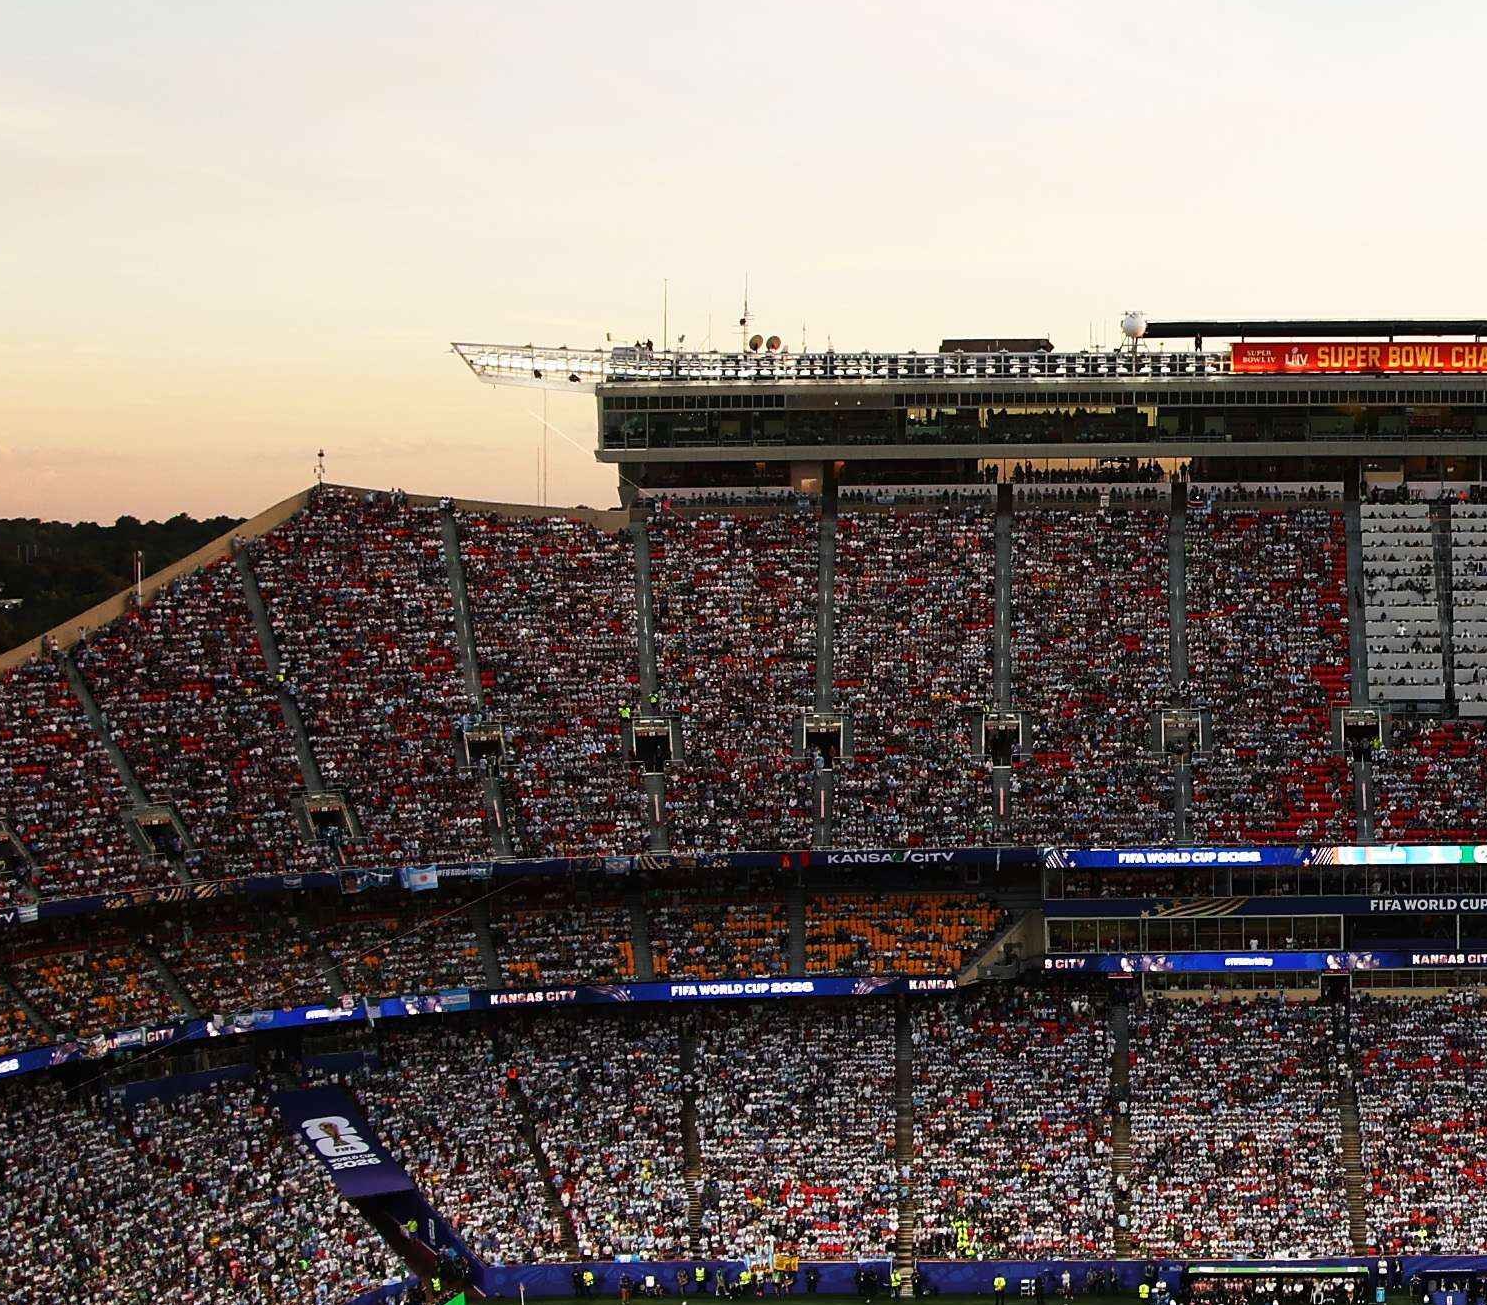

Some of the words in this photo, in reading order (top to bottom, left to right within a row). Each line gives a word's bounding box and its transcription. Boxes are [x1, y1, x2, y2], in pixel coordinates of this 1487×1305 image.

[1317, 347, 1381, 369] SUPER
[1388, 347, 1444, 369] BOWL
[910, 852, 955, 863] CITY
[1118, 852, 1145, 863] FIFA
[1146, 852, 1190, 863] WORLD
[1192, 852, 1216, 863] CUP
[1370, 899, 1401, 911] FIFA
[1404, 899, 1457, 911] WORLD
[1057, 958, 1086, 969] CITY
[1413, 954, 1464, 964] KANSAS
[671, 985, 696, 997] FIFA
[699, 984, 742, 996] WORLD
[744, 983, 769, 995] CUP
[771, 982, 813, 993] 2026
[909, 979, 956, 990] KANSA
[490, 992, 543, 1005] KANSAS
[546, 990, 577, 1003] CITY
[331, 1157, 382, 1171] 2026
